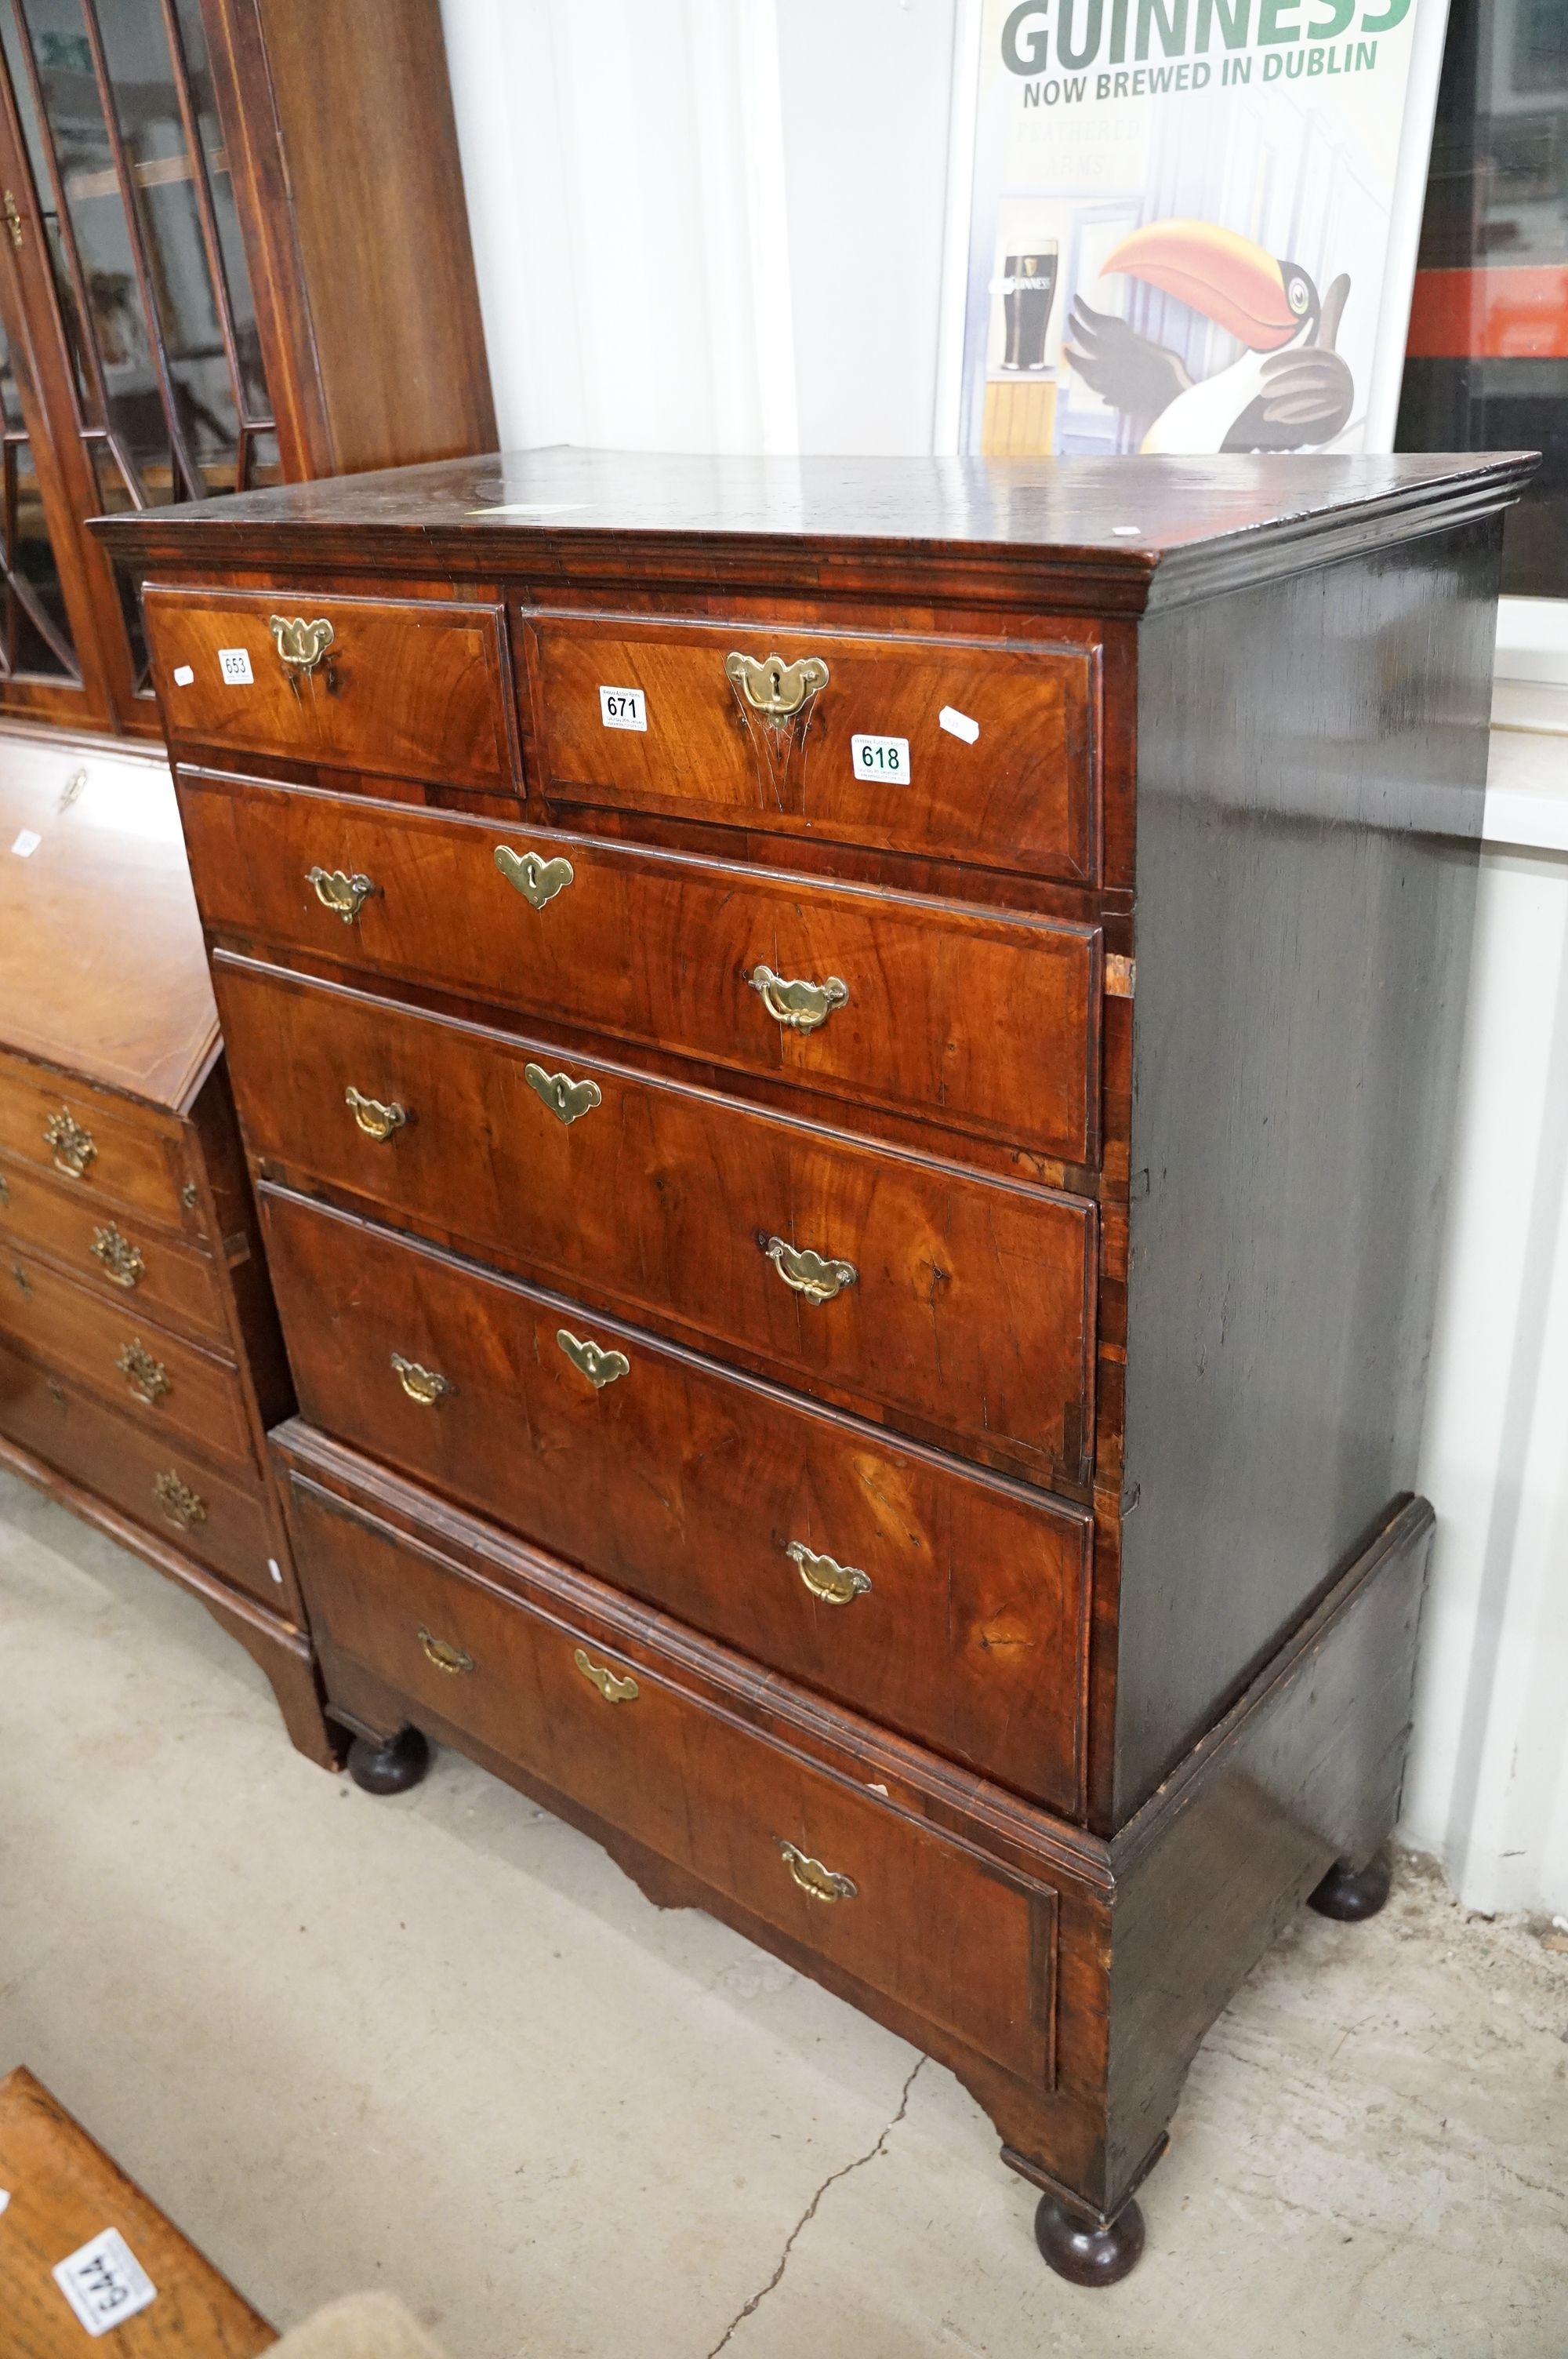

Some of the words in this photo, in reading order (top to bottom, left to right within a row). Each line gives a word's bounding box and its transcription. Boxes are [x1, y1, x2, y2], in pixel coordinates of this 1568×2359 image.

[1023, 76, 1087, 108] NOW
[1096, 62, 1211, 100] BREWED
[1221, 56, 1252, 86] IN
[1263, 41, 1377, 82] DUBLIN
[1016, 119, 1141, 143] FEATHERED
[1045, 153, 1105, 176] ARMS
[225, 657, 246, 674] 653
[607, 696, 637, 718] 671
[862, 746, 900, 769] 618
[79, 2255, 129, 2311] 644
